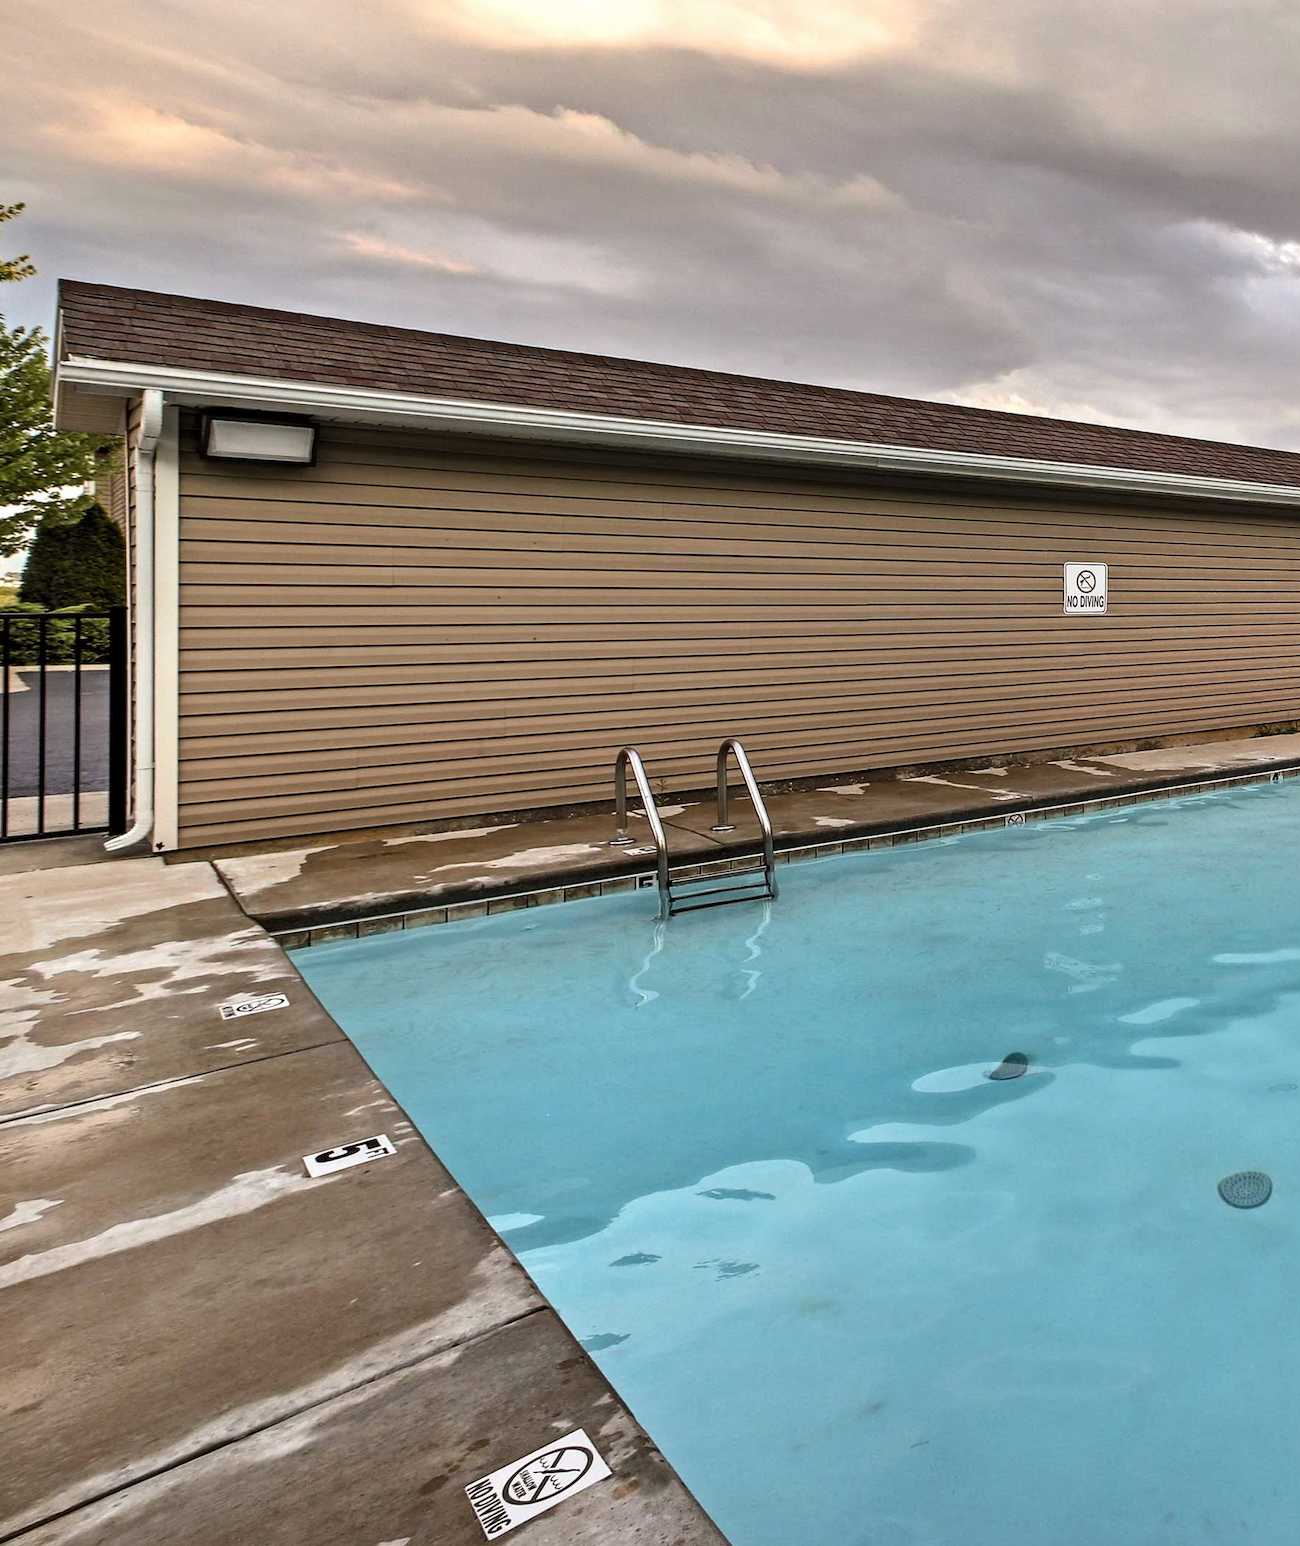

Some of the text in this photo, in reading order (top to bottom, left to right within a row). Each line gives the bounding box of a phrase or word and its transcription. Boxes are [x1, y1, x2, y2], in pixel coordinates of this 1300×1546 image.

[1067, 595, 1104, 607] NO DIVING
[314, 1138, 381, 1163] 5
[511, 1481, 527, 1498] WATER
[519, 1469, 538, 1491] SHALLOW
[466, 1478, 512, 1535] NO DIVING
